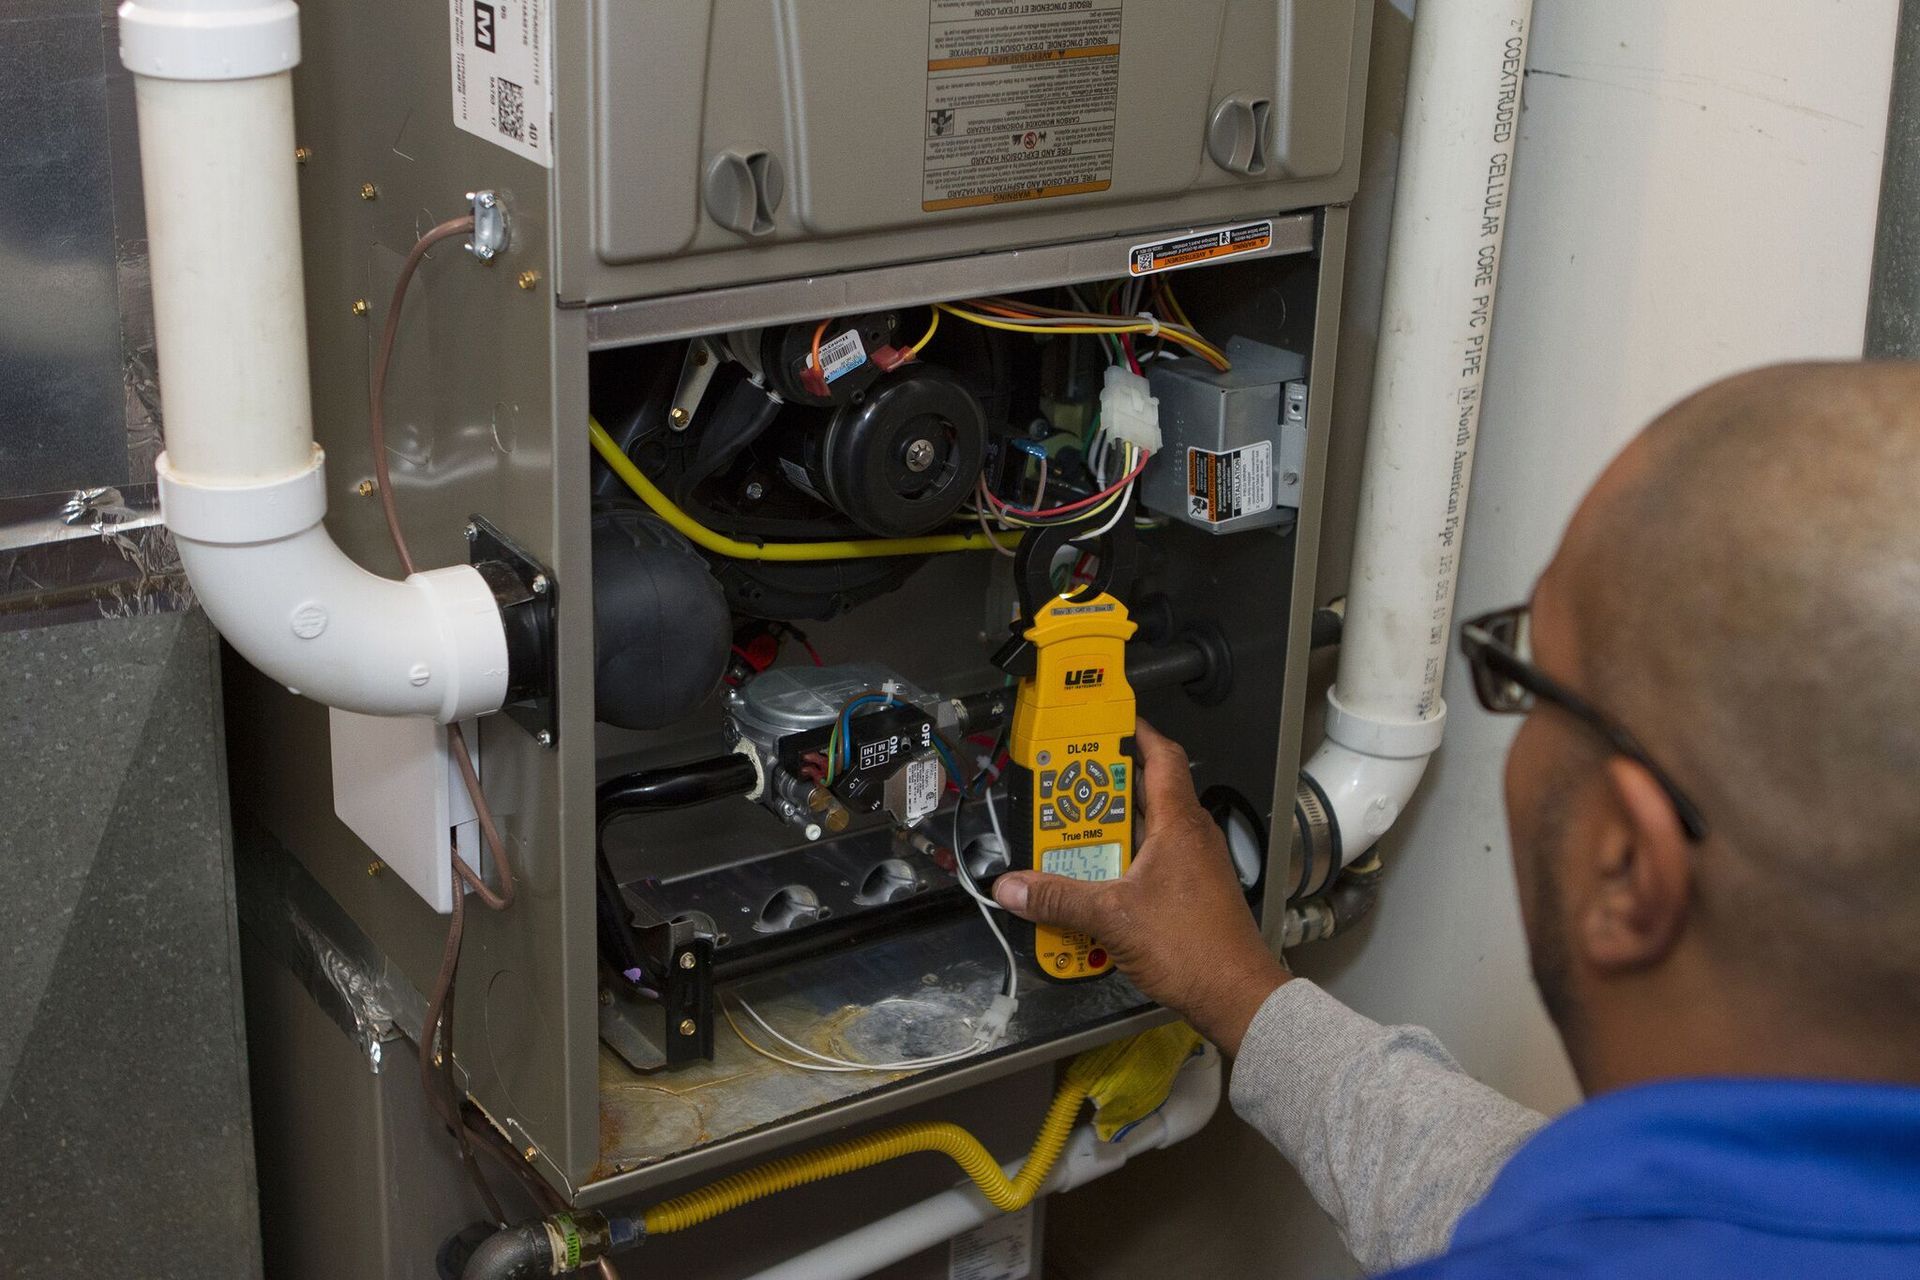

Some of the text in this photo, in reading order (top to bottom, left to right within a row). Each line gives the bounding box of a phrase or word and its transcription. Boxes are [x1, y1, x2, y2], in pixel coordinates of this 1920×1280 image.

[974, 3, 1019, 18] D'EXPLOSION
[1030, 0, 1067, 14] D'INCENDIE
[1068, 0, 1092, 10] RISQUE
[1000, 41, 1043, 54] D'EXPLOSION
[1085, 35, 1108, 46] RISQUE
[948, 45, 988, 59] D'ASPHYXIE
[1493, 37, 1523, 144] COEXTRUDED
[966, 115, 1079, 134] CARBON MONOXIDE POISONING HAZARD
[529, 122, 538, 149] 401
[970, 146, 1071, 165] FIRE AND EXPLOSION HAZARD
[1026, 179, 1041, 188] AND
[1042, 174, 1079, 186] EXPLOSION
[1080, 172, 1096, 181] FIRE,
[947, 187, 976, 198] HAZARD
[992, 190, 1030, 201] WARNING
[1481, 153, 1508, 238] CELLULAR
[1474, 245, 1496, 287] CORE
[1469, 296, 1489, 328] PVC
[1462, 335, 1484, 377] PIPE
[1457, 405, 1474, 446] North
[1447, 451, 1467, 514] American
[1438, 516, 1459, 547] Pipe
[921, 723, 930, 747] OFF
[863, 747, 873, 756] HI
[890, 736, 898, 754] ON
[1068, 742, 1099, 754] DL429
[1062, 829, 1103, 841] True RMS
